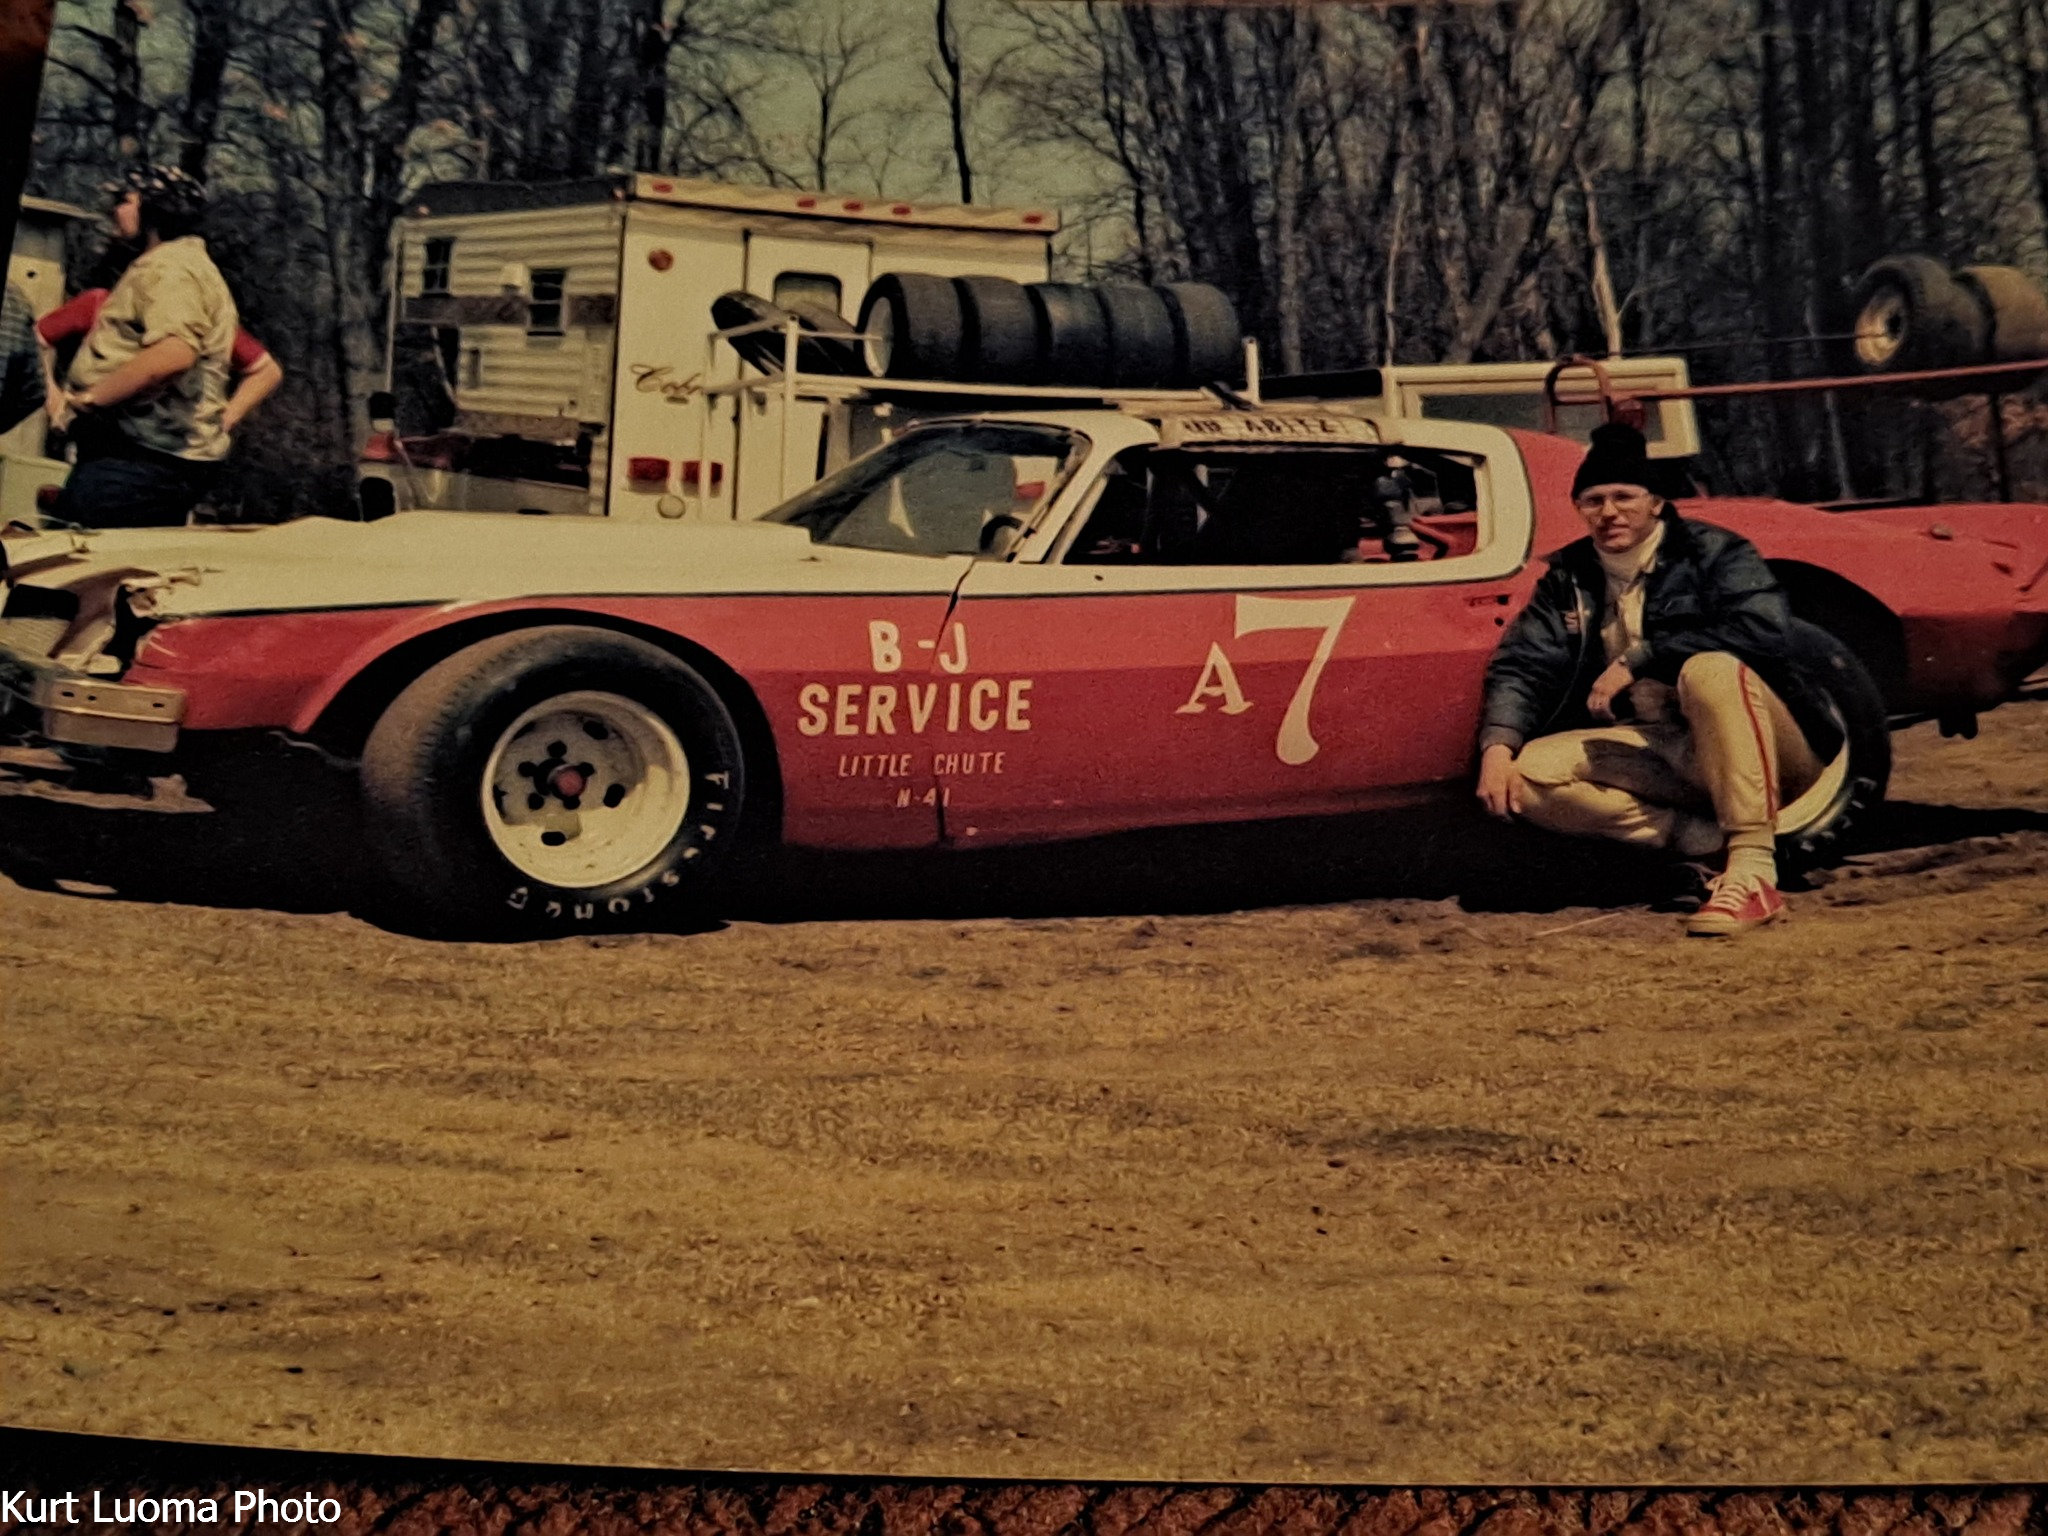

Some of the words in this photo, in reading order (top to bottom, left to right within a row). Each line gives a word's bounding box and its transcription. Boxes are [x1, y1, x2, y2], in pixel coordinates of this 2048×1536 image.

[798, 679, 1033, 736] SERVICE
[837, 754, 913, 777] LITTLE
[934, 752, 1006, 775] CHUTE
